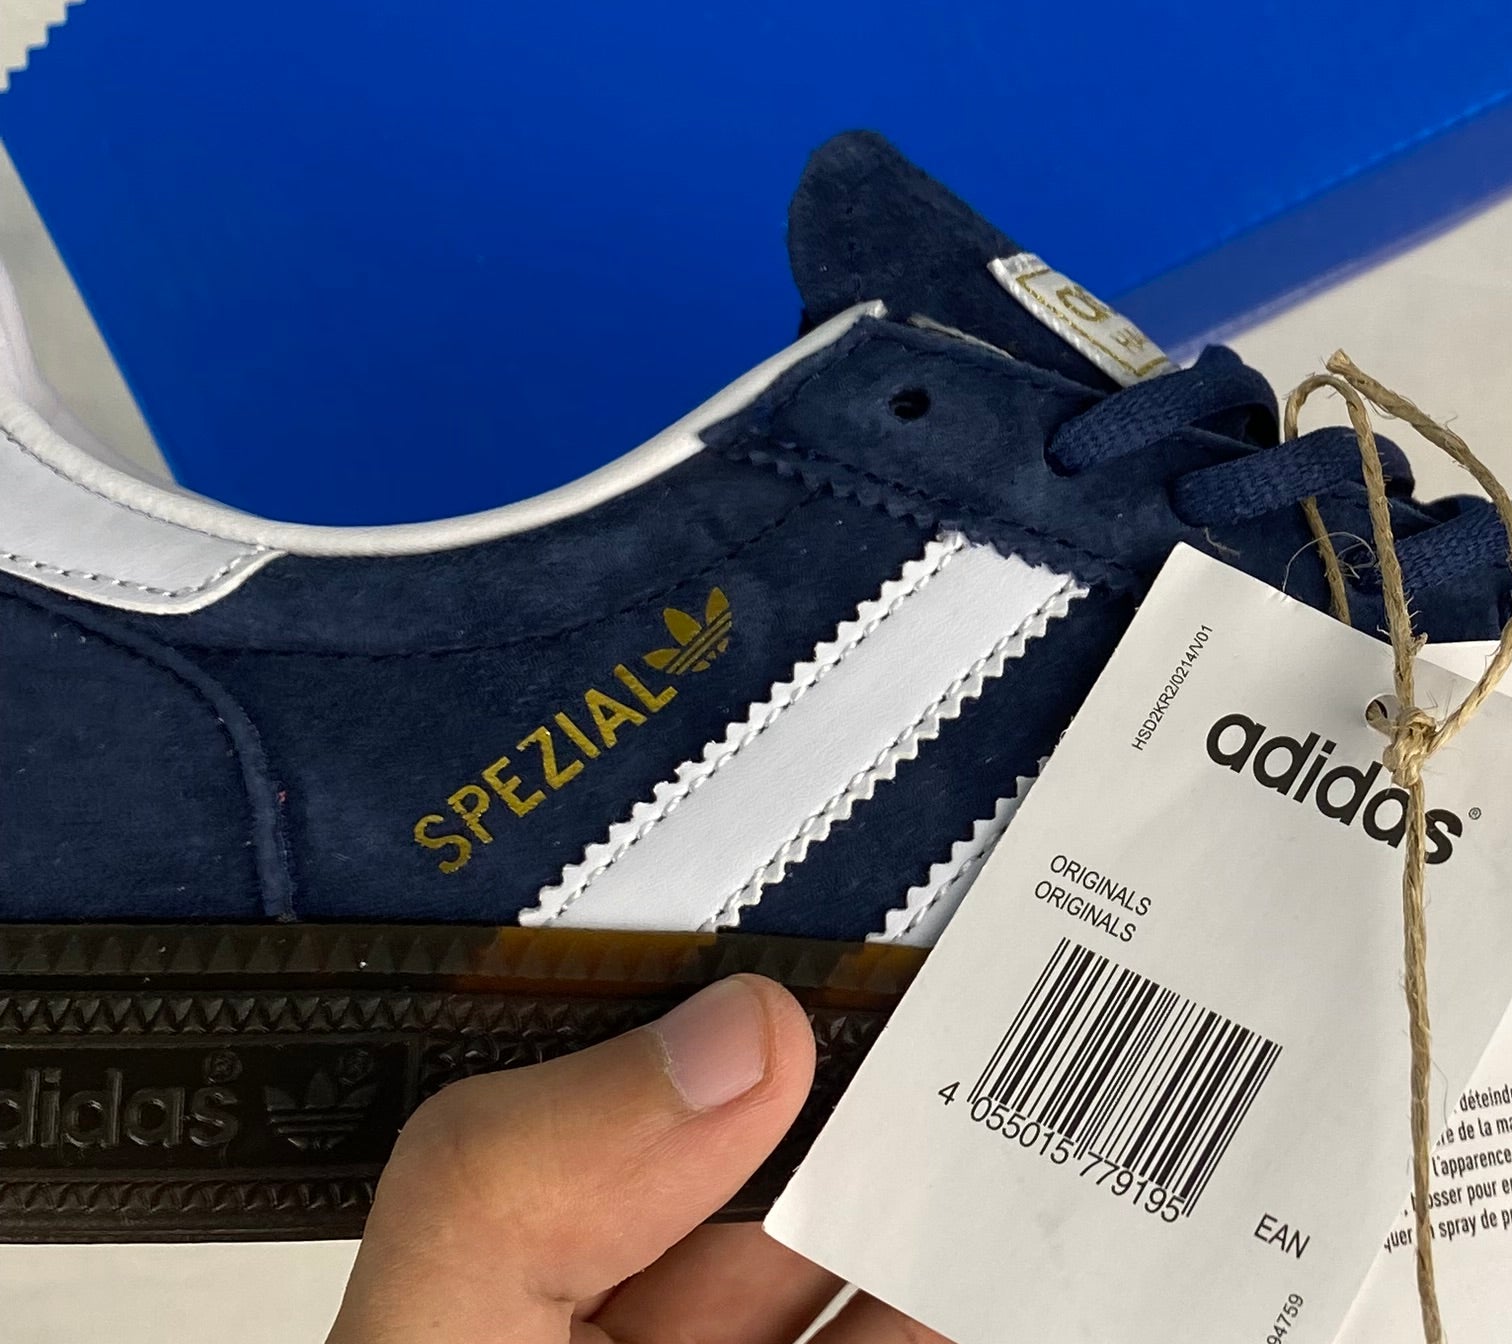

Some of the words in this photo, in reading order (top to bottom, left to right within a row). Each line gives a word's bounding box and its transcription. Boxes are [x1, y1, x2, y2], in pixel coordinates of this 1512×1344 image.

[1131, 624, 1213, 751] HSD2KR2/0214/V01
[413, 663, 679, 875] SPEZIAL
[1206, 713, 1464, 865] adidas
[1034, 880, 1137, 943] ORIGINALS
[1050, 854, 1152, 916] ORIGINALS
[1458, 1120, 1475, 1143] de
[1478, 1116, 1493, 1138] la
[1467, 1179, 1498, 1206] pour
[1253, 1211, 1311, 1260] EAN
[1438, 1214, 1477, 1241] spray
[1480, 1207, 1499, 1229] de
